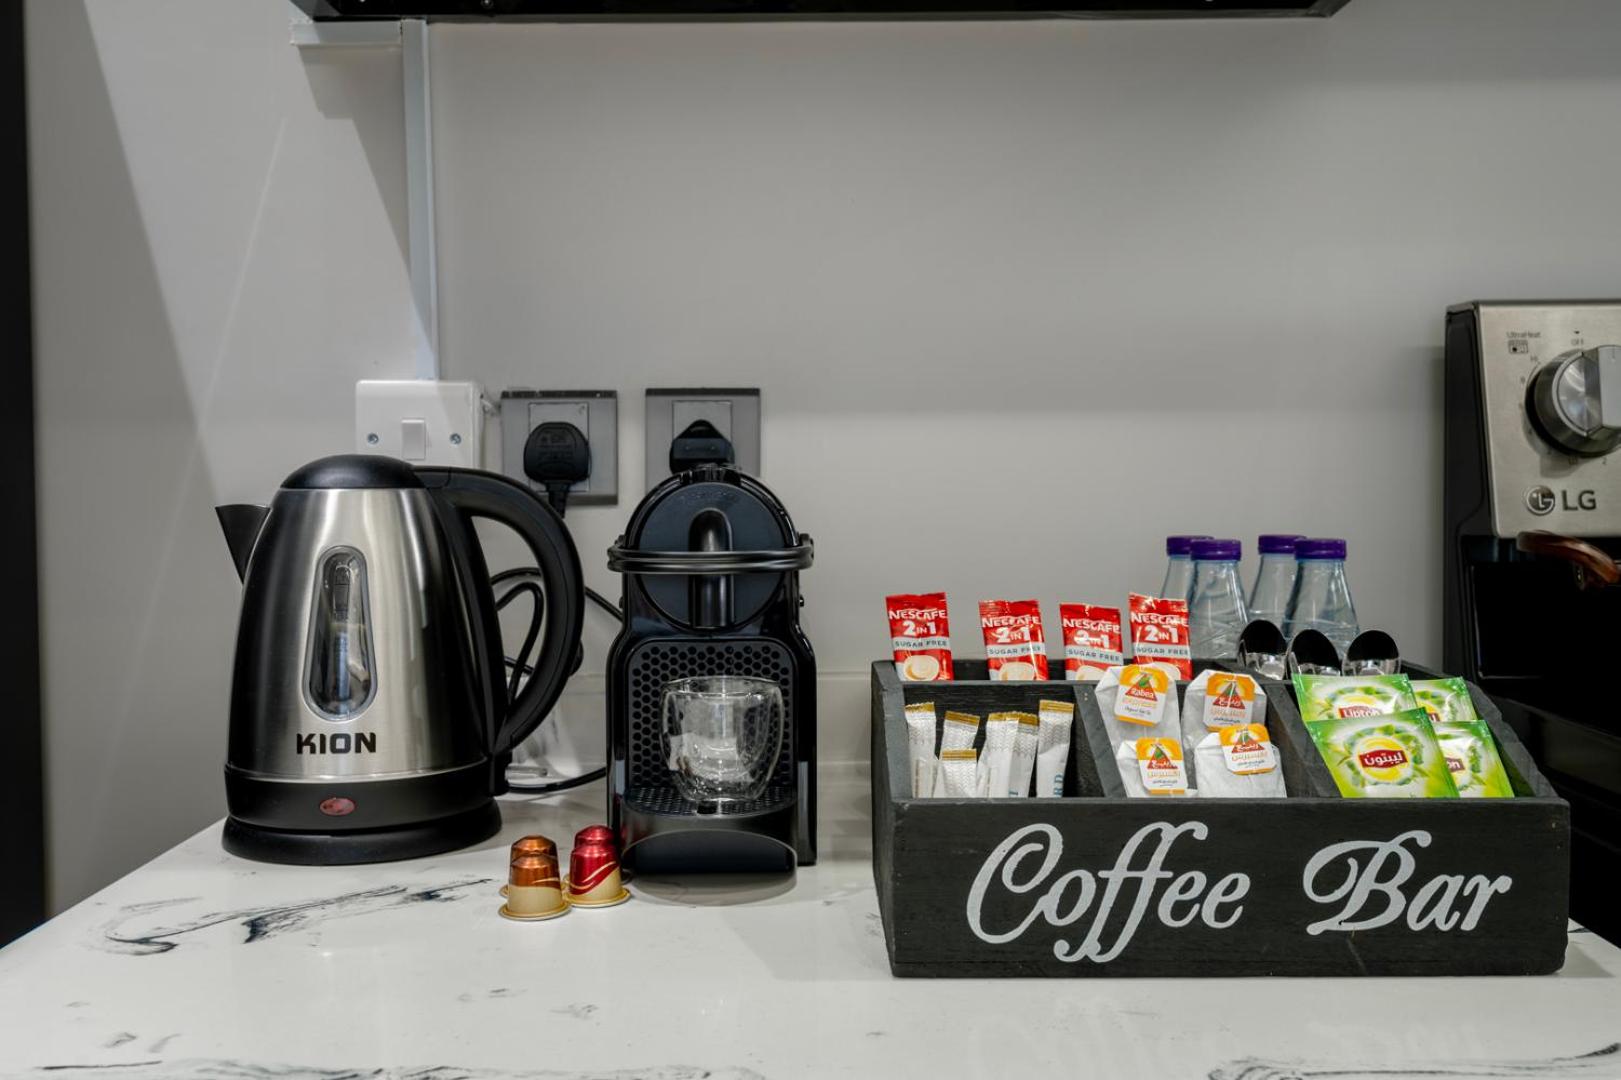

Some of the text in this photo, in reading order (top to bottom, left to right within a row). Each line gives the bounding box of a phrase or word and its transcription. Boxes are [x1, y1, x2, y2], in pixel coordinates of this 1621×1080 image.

[1561, 490, 1597, 511] LG
[902, 620, 916, 636] 2
[927, 621, 937, 635] 1
[996, 627, 1010, 643] 2
[1144, 624, 1159, 642] 2
[895, 640, 924, 648] SUGAR
[1068, 648, 1120, 661] SUGAR FREE
[296, 732, 376, 754] KION
[1364, 752, 1403, 766] ليبتون
[966, 821, 1513, 963] Coffee Bar
